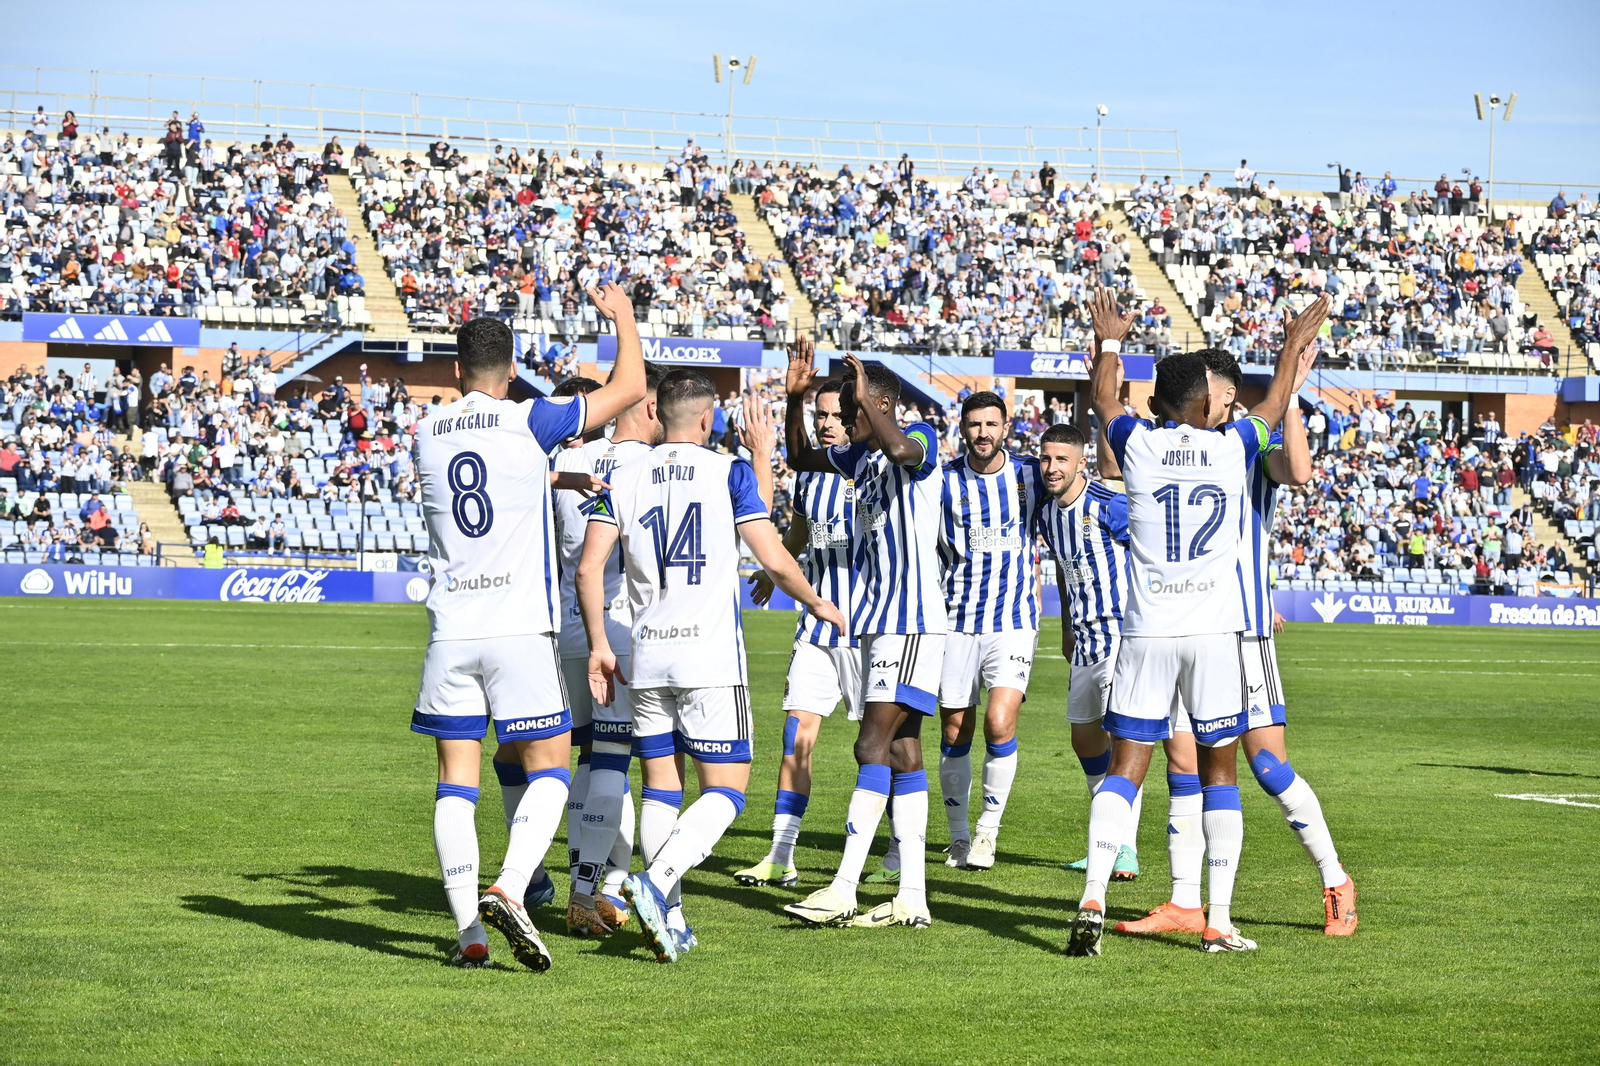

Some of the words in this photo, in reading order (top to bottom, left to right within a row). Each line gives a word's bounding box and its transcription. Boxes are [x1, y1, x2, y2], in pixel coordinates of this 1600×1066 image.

[433, 417, 453, 437] LUIS
[454, 413, 500, 431] ALCALDE
[1161, 450, 1196, 467] JOSIEL
[1200, 450, 1212, 467] N.
[652, 466, 666, 484] DEL
[669, 464, 695, 481] POZO
[447, 451, 494, 538] 8
[969, 526, 999, 537] alter
[1151, 483, 1227, 563] 12
[638, 502, 707, 590] 14
[63, 569, 132, 595] WiHu
[220, 568, 329, 602] Coca-Cola
[1349, 595, 1392, 613] CAJA
[1395, 597, 1455, 614] RURAL
[1489, 603, 1551, 625] Fresón
[1552, 604, 1574, 625] de
[1374, 614, 1400, 625] DEL
[1402, 615, 1428, 626] SUR
[506, 715, 562, 733] ROMERO
[1197, 716, 1238, 733] ROMERO
[1096, 840, 1118, 854] 1889
[446, 863, 473, 877] 1889
